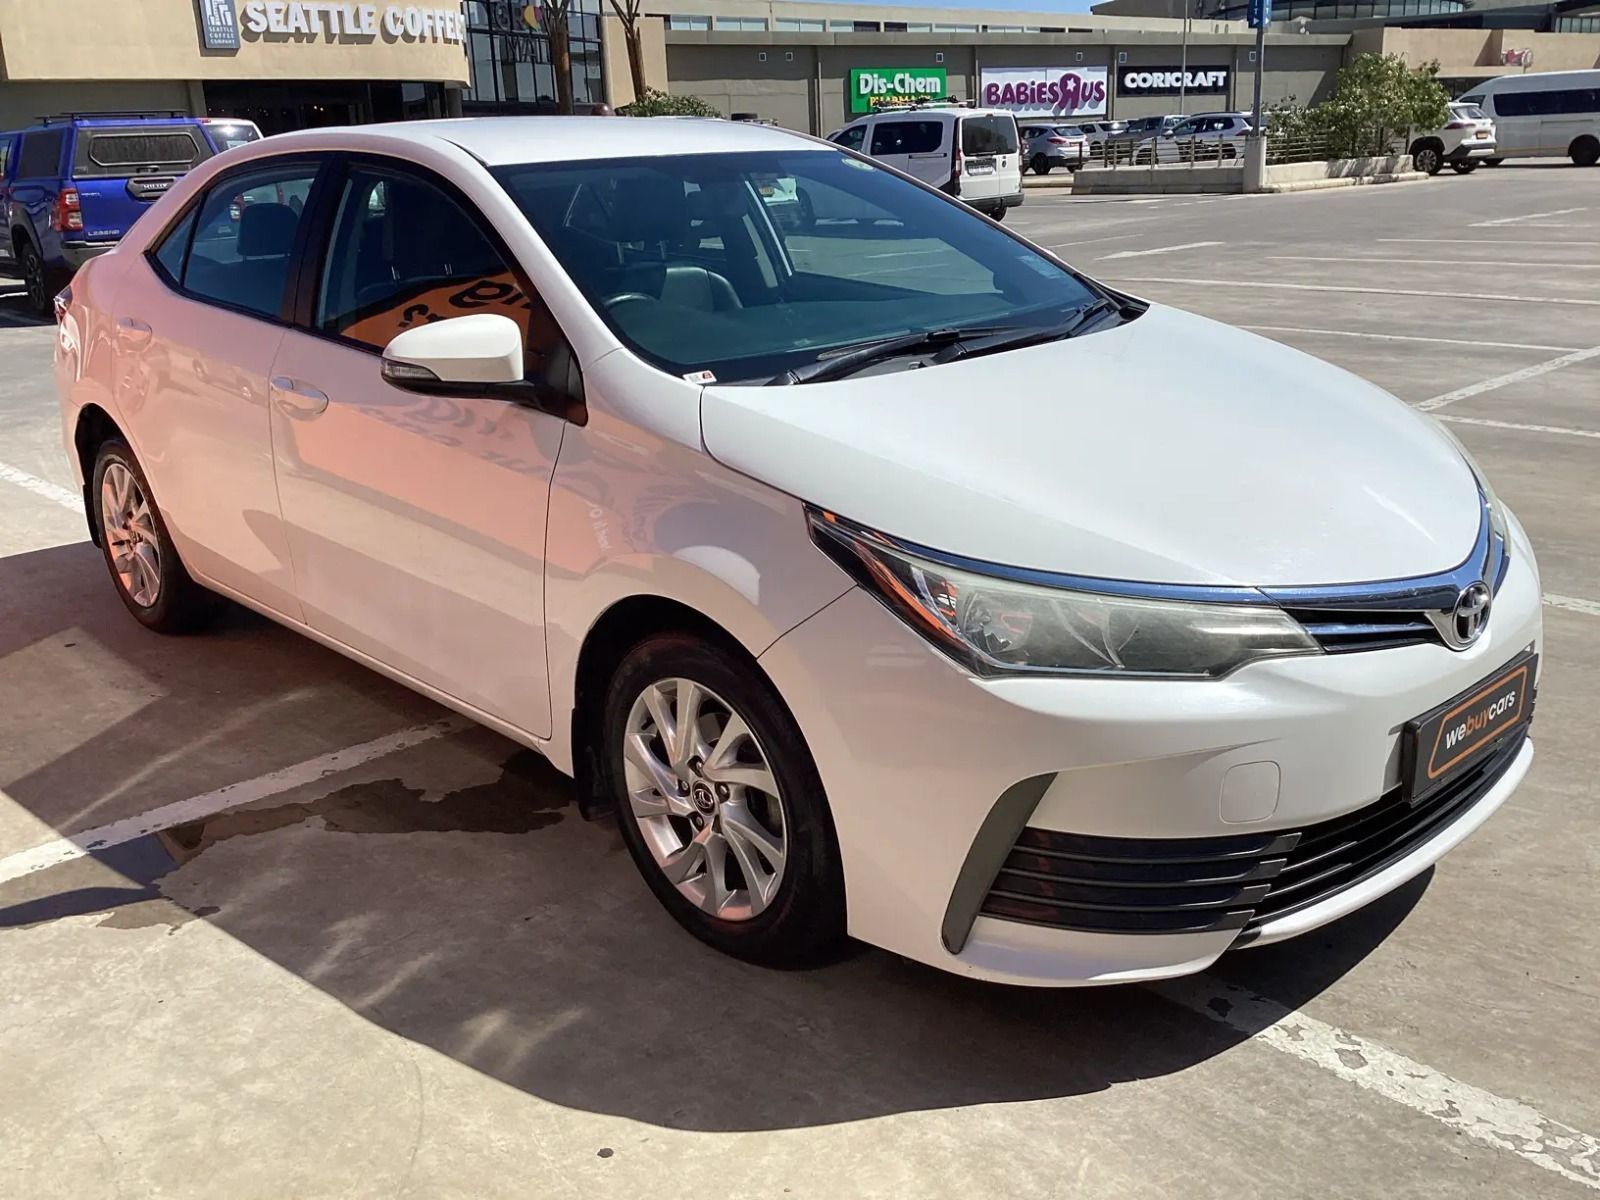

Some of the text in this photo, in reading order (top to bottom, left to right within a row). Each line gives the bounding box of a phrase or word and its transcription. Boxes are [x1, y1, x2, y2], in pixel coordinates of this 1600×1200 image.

[246, 2, 377, 34] SEATTLE
[859, 72, 941, 94] Dis-Chem
[1124, 71, 1227, 88] CORICRAFT
[1081, 80, 1105, 102] US
[1446, 690, 1516, 750] webuycars
